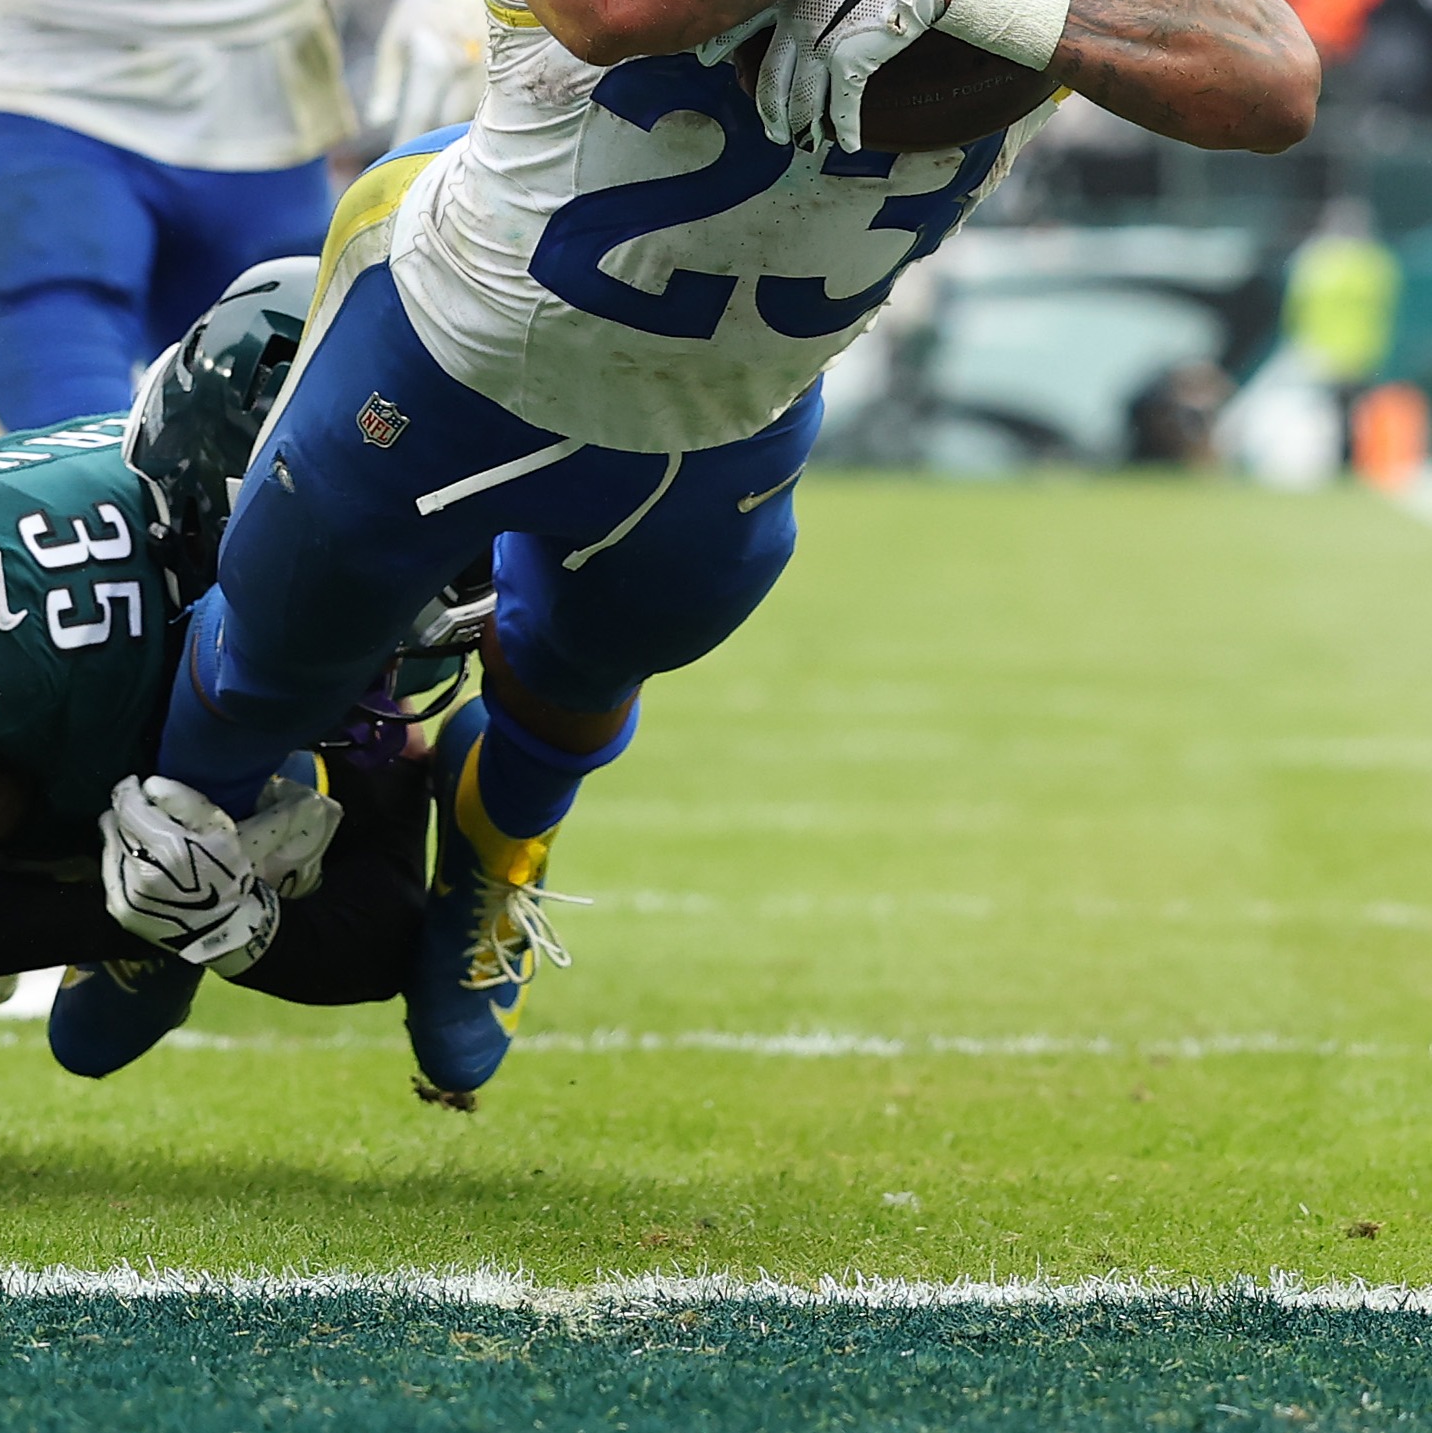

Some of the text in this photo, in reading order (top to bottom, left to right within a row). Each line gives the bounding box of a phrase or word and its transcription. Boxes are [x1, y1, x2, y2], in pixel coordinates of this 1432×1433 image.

[528, 53, 1010, 340] 23
[362, 410, 391, 442] NFL
[18, 502, 142, 650] 35
